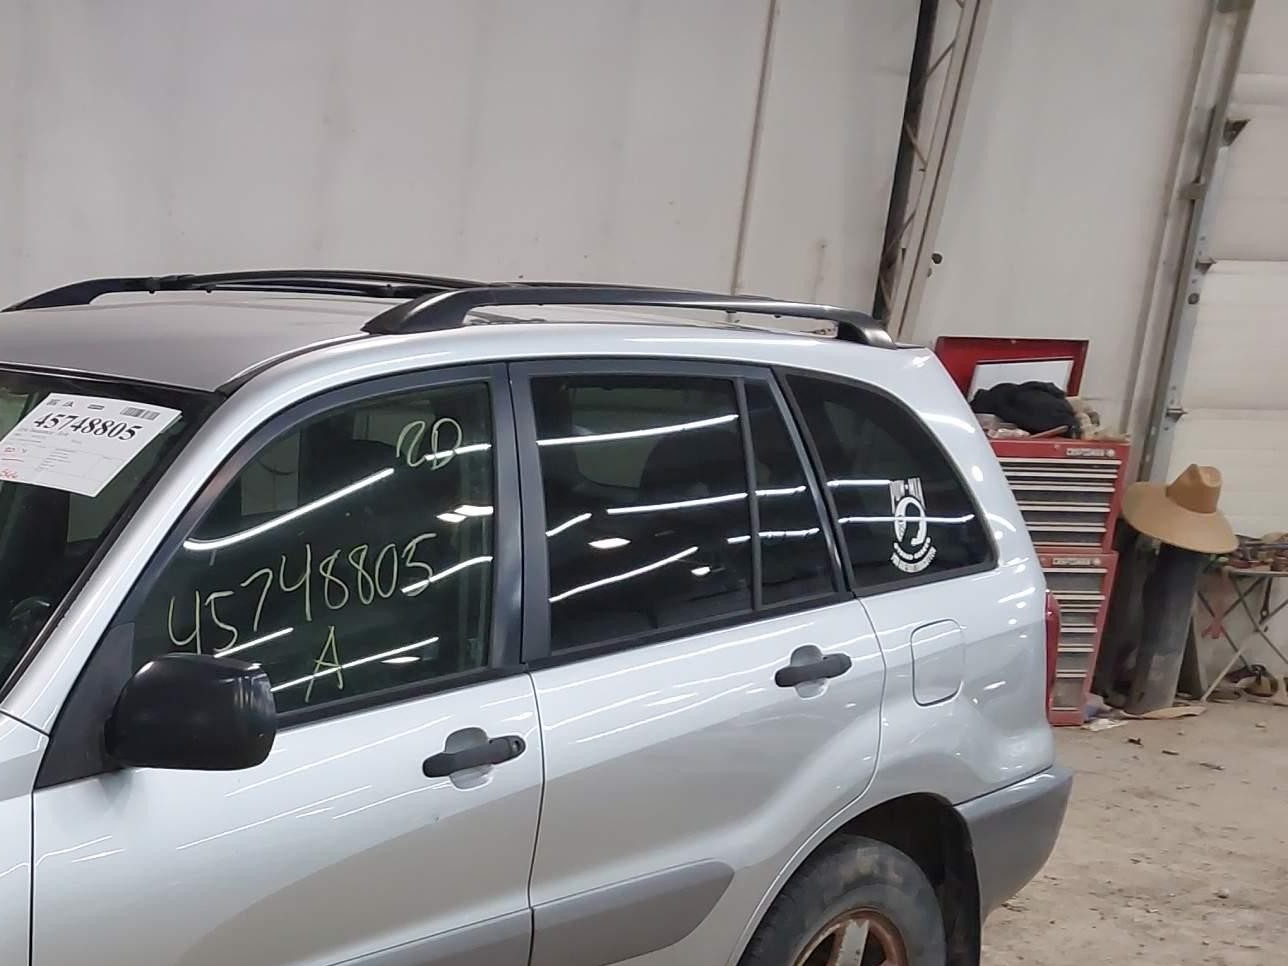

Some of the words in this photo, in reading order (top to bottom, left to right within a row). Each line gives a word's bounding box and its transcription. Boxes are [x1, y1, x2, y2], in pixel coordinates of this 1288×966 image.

[33, 412, 143, 442] 45748805
[167, 532, 438, 656] 45748805
[304, 625, 345, 703] A
